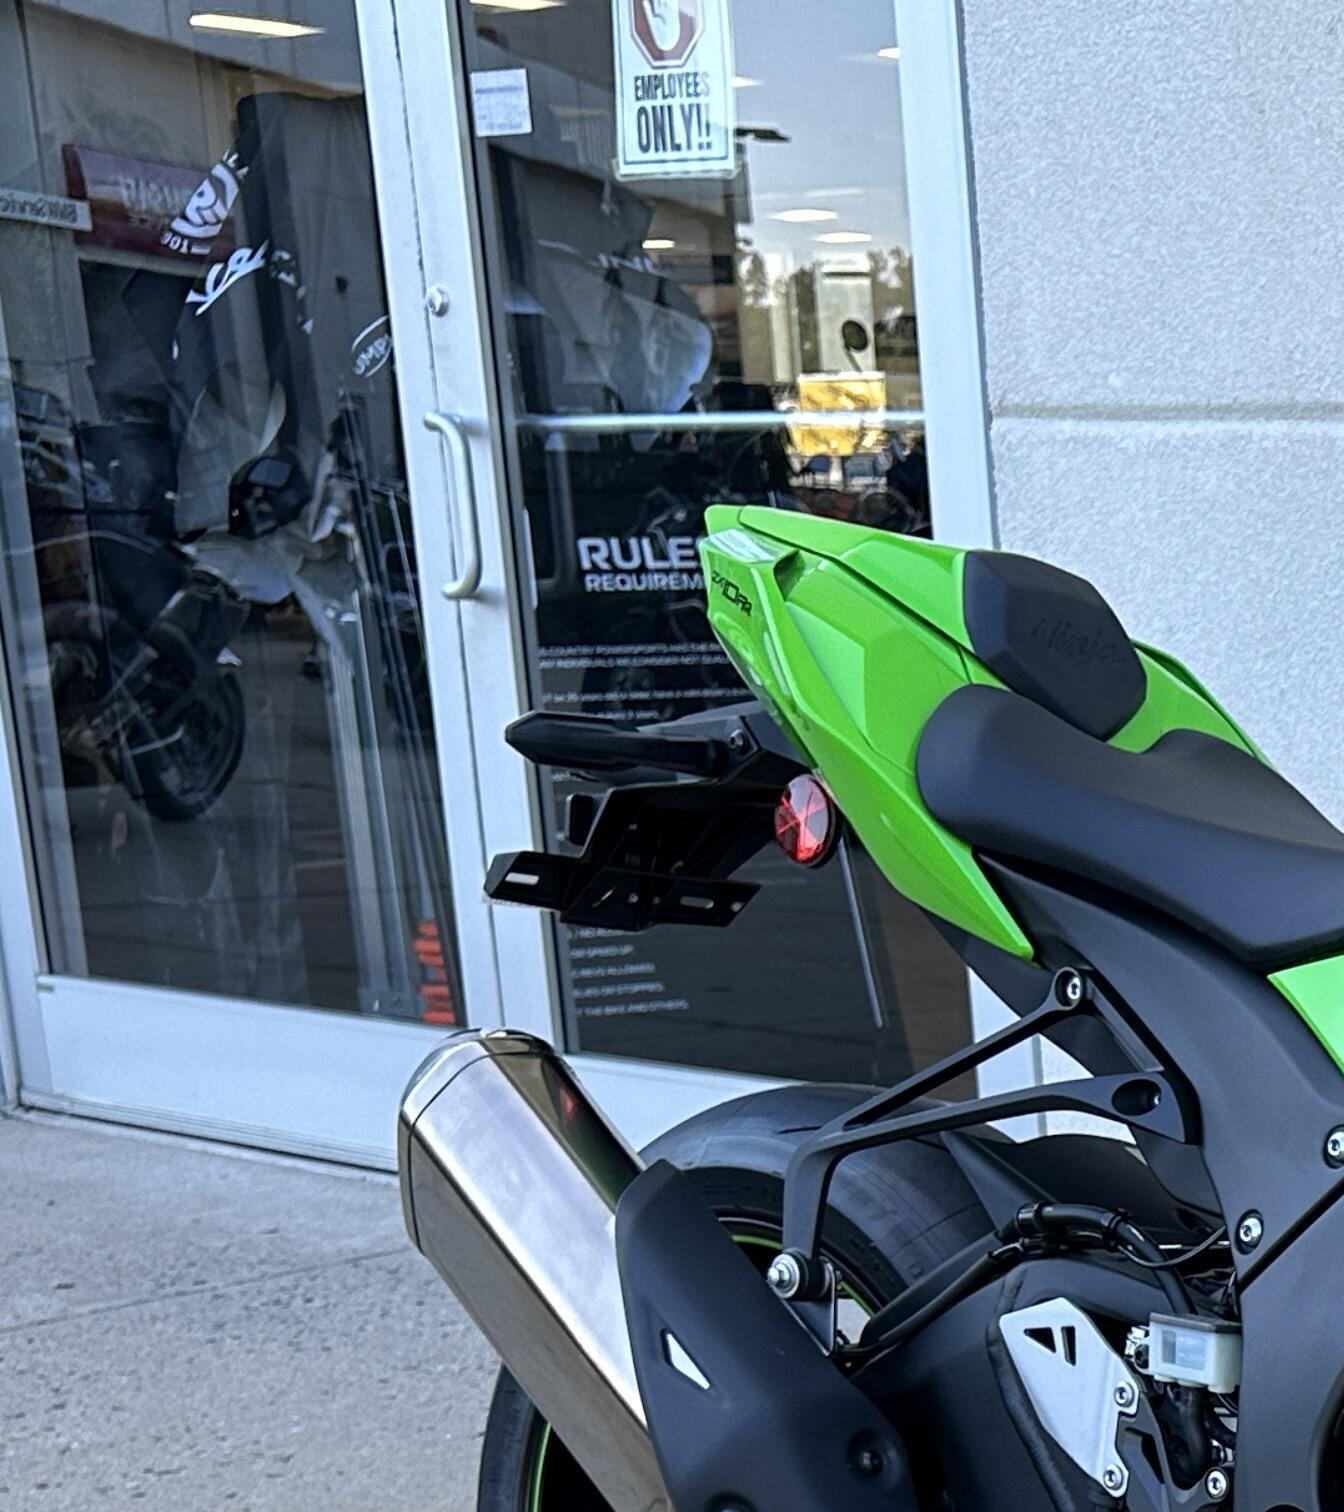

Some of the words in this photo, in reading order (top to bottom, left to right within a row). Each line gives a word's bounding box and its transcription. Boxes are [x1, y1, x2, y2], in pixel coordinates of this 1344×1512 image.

[634, 72, 709, 100] EMPLOYEES
[637, 103, 712, 153] ONLY!!
[576, 536, 702, 570] RULE
